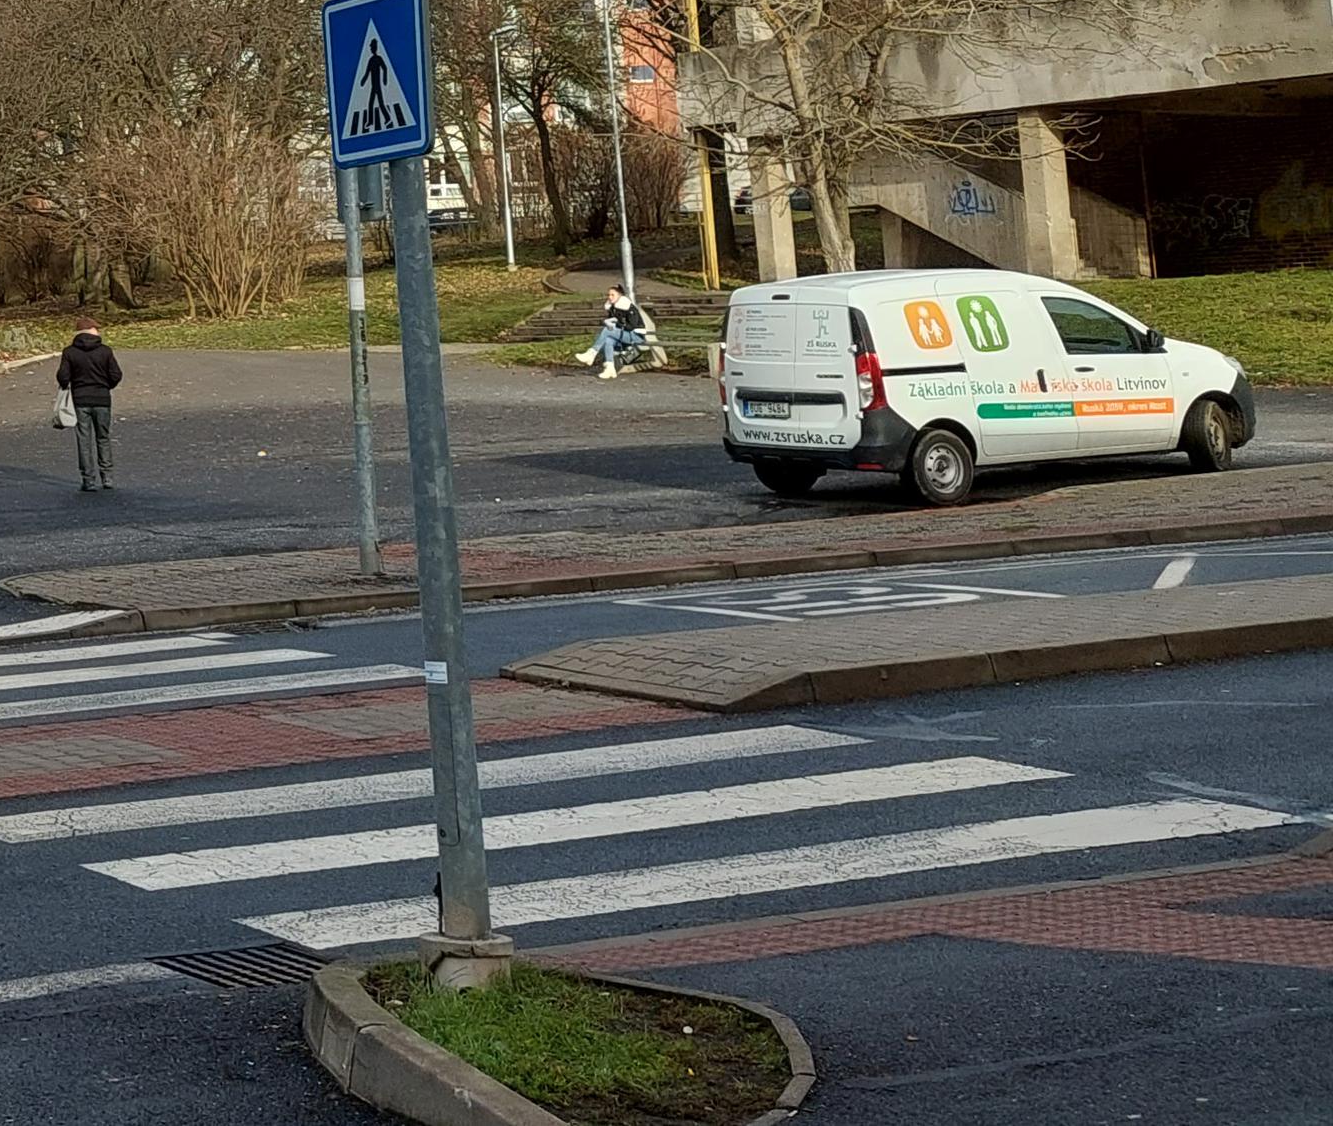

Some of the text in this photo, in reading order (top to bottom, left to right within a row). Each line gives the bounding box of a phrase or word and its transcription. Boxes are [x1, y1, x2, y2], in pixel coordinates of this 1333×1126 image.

[908, 376, 1167, 398] Základní škola a Mařská škola Litvínov
[742, 429, 846, 445] www.zsruska.cz
